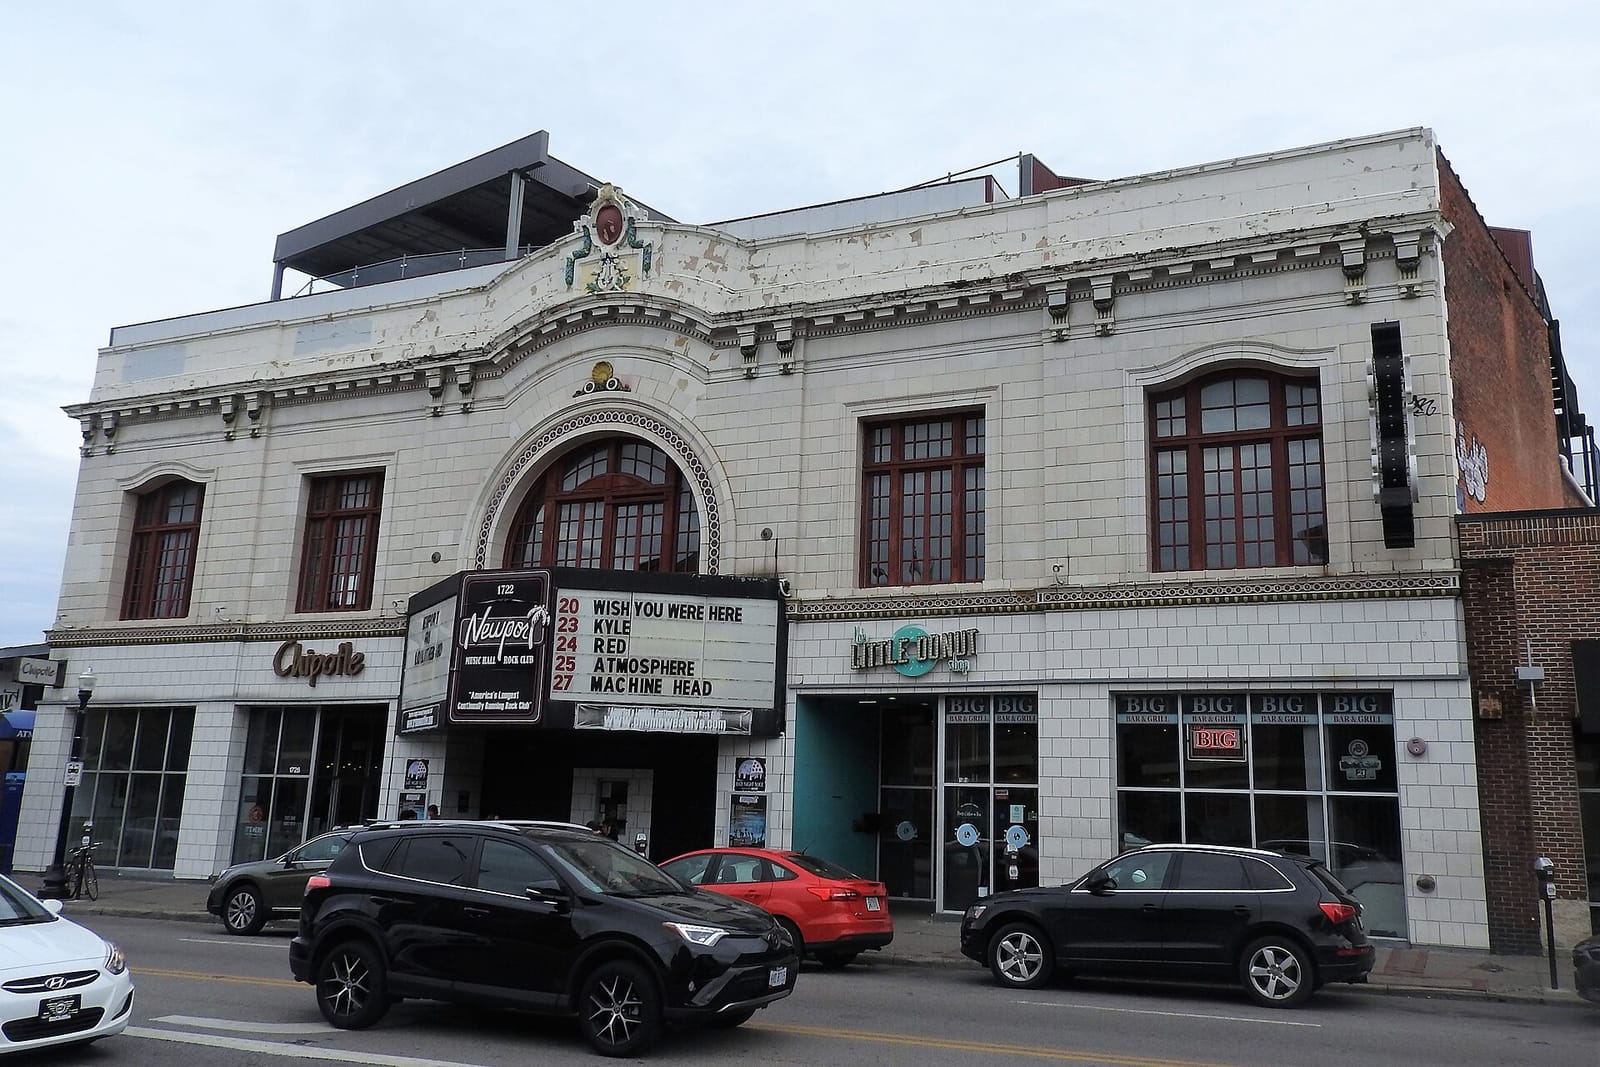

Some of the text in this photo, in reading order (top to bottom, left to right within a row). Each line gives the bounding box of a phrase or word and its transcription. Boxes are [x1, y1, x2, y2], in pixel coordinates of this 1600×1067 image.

[558, 598, 742, 622] 20 WISH YOU WERE HERE
[557, 617, 631, 635] 23 KYLE
[556, 636, 627, 654] 24 RED
[850, 628, 980, 670] LITTLE DONUT
[273, 640, 365, 687] Chipotle
[503, 655, 519, 664] ROCK
[520, 655, 534, 664] CLUB
[555, 656, 695, 676] 25 ATMOSPHERE
[22, 662, 56, 678] Chipotle
[552, 674, 713, 696] 27 MACHINE HEAD
[950, 697, 985, 713] BIG
[998, 697, 1033, 712] BIG
[1126, 697, 1165, 713] BIG
[1192, 697, 1233, 713] BIG
[1261, 696, 1304, 713] BIG
[1333, 696, 1377, 713] BIG
[1195, 730, 1238, 749] BIG
